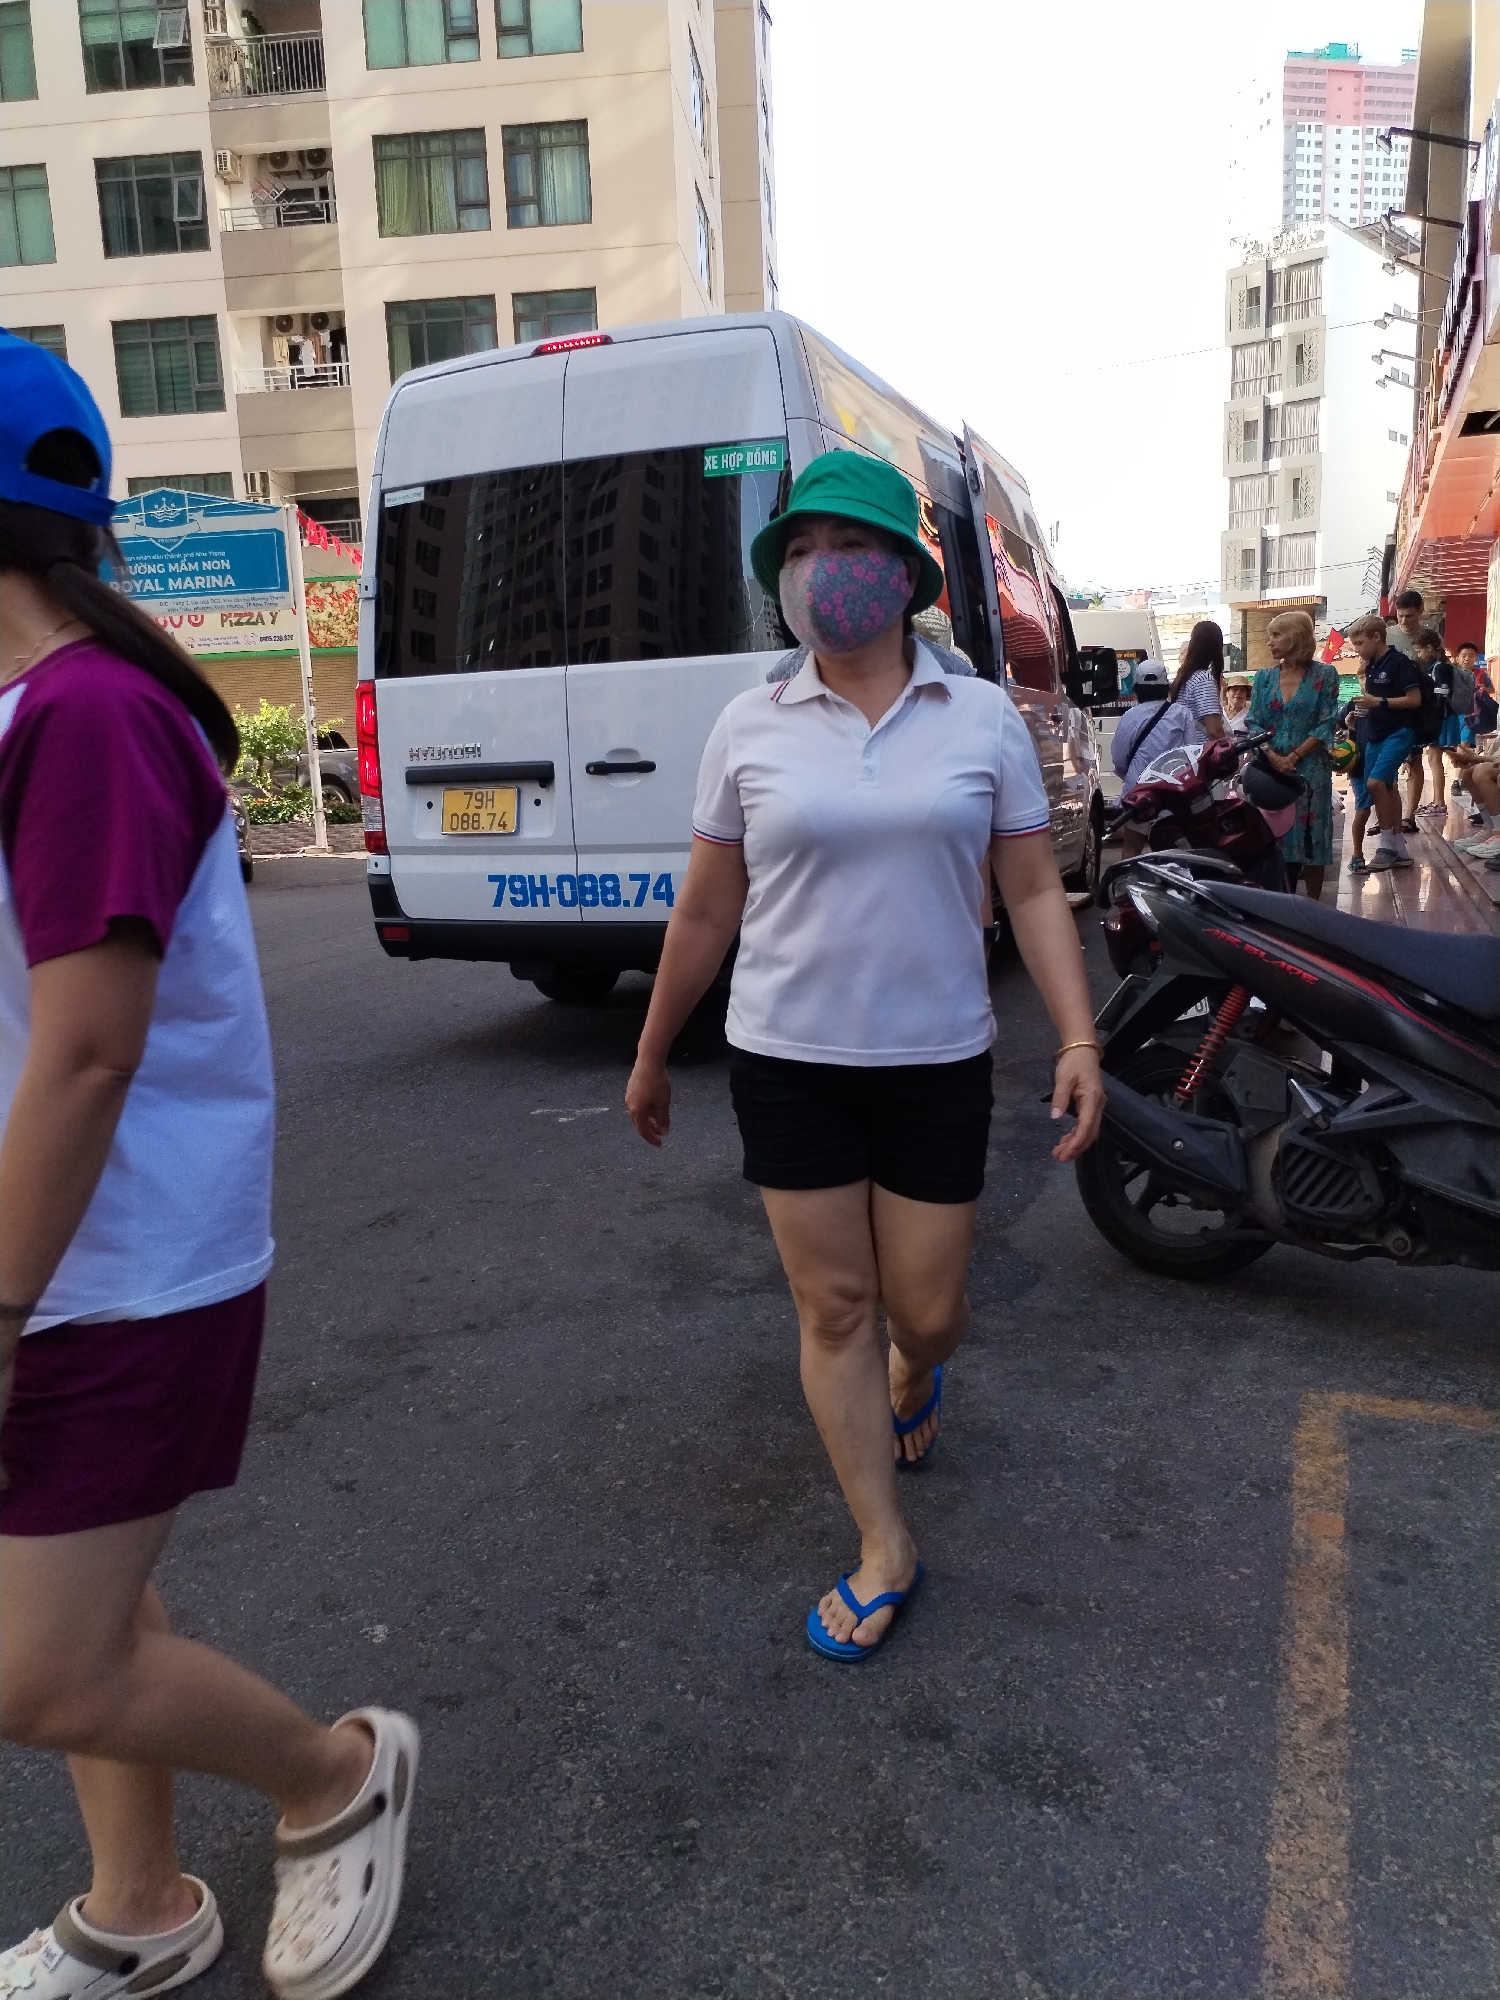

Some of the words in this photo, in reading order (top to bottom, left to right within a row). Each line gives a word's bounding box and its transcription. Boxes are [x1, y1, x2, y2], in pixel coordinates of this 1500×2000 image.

[704, 455, 718, 471] XE
[721, 451, 744, 471] HỢP
[746, 447, 777, 467] ĐỒNG
[202, 559, 231, 571] NON
[109, 578, 165, 593] ROYAL
[168, 575, 236, 591] MARINA
[220, 611, 265, 628] PIZZA
[409, 743, 481, 761] HYUNDAI
[463, 790, 496, 810] 79H
[450, 811, 508, 831] 088.74
[487, 873, 675, 908] 79H-088.74
[1201, 928, 1242, 948] AIR
[1243, 943, 1319, 985] BLADE
